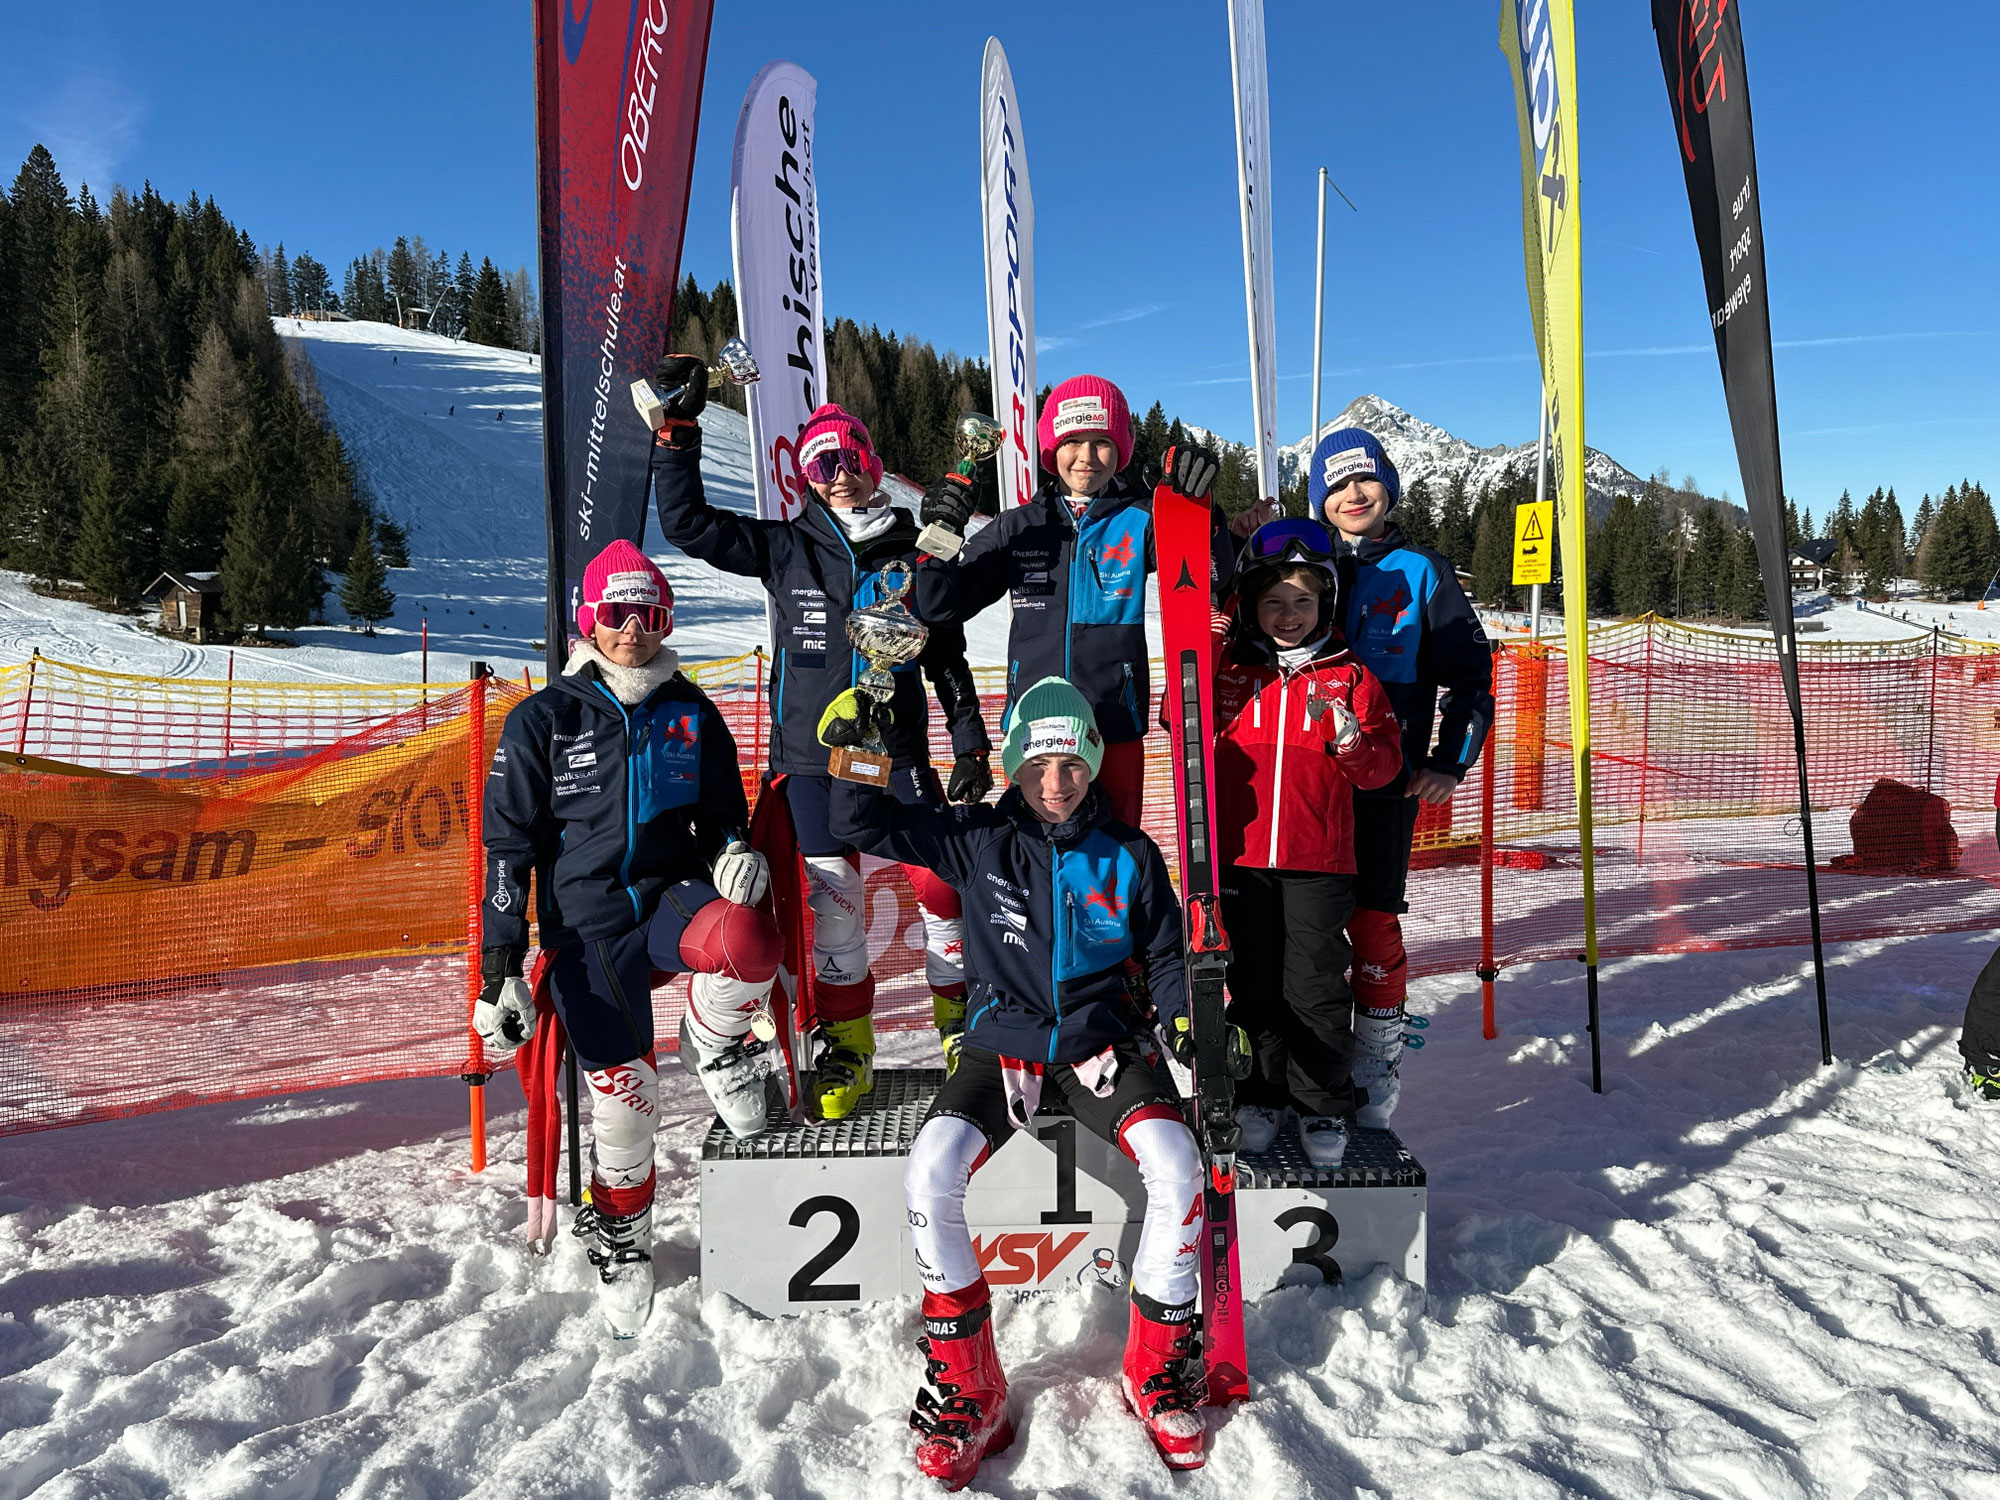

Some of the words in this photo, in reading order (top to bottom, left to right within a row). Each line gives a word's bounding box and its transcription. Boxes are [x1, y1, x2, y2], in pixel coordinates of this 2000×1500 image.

[579, 255, 628, 541] ski-mittelschule.at
[1023, 736, 1076, 751] energieAG
[1095, 917, 1121, 928] Austria
[1367, 1006, 1398, 1017] SIDAS
[1038, 1119, 1092, 1225] 1
[788, 1195, 861, 1302] 2
[1268, 1206, 1344, 1293] 3
[926, 1320, 958, 1335] SIDAS
